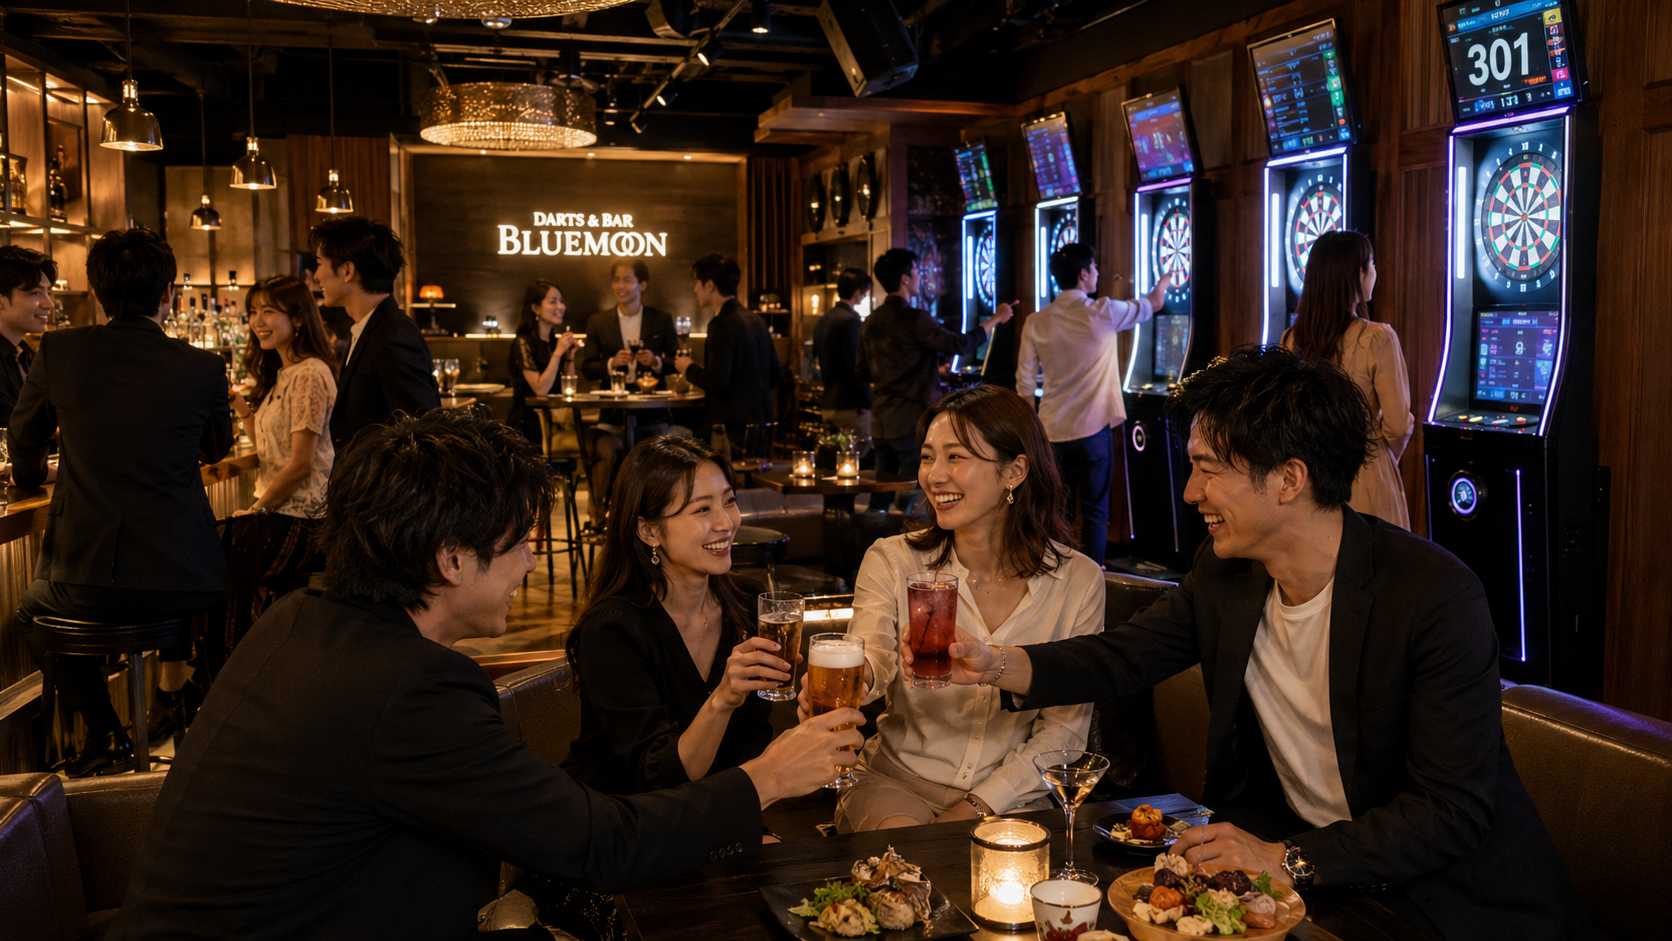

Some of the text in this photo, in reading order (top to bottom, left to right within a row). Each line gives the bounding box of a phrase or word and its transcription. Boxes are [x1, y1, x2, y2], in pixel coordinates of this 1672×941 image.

[1467, 32, 1529, 86] 301
[533, 211, 634, 228] DARTS & BAR
[497, 224, 668, 257] BLUEMOON
